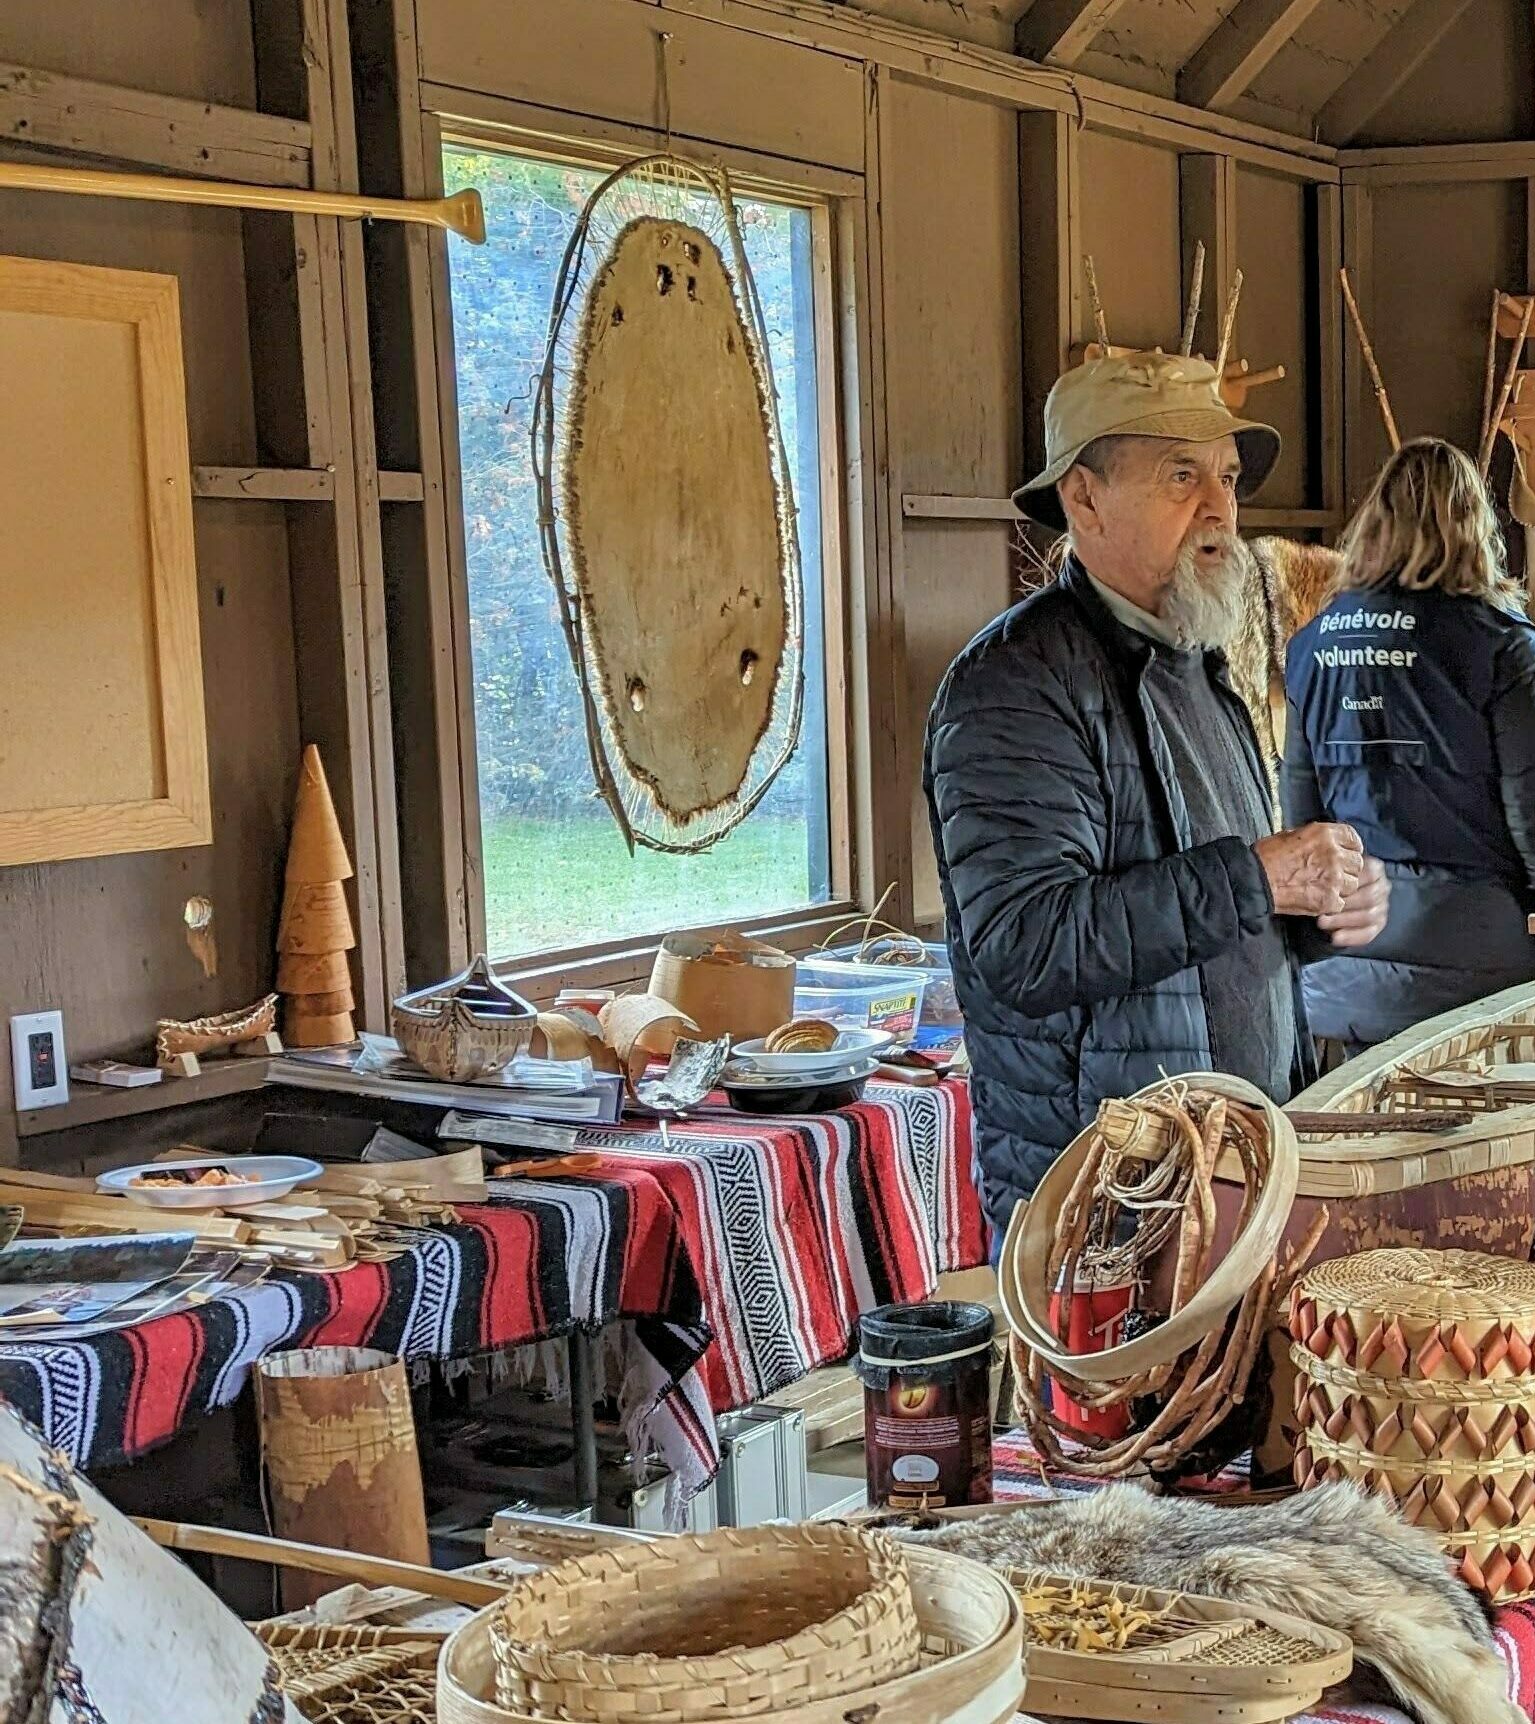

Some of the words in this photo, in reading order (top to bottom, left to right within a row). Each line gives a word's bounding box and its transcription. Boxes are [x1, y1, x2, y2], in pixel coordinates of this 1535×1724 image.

[1319, 608, 1417, 635] Bénévole
[1313, 645, 1418, 671] Volunteer
[1342, 695, 1384, 711] Canada
